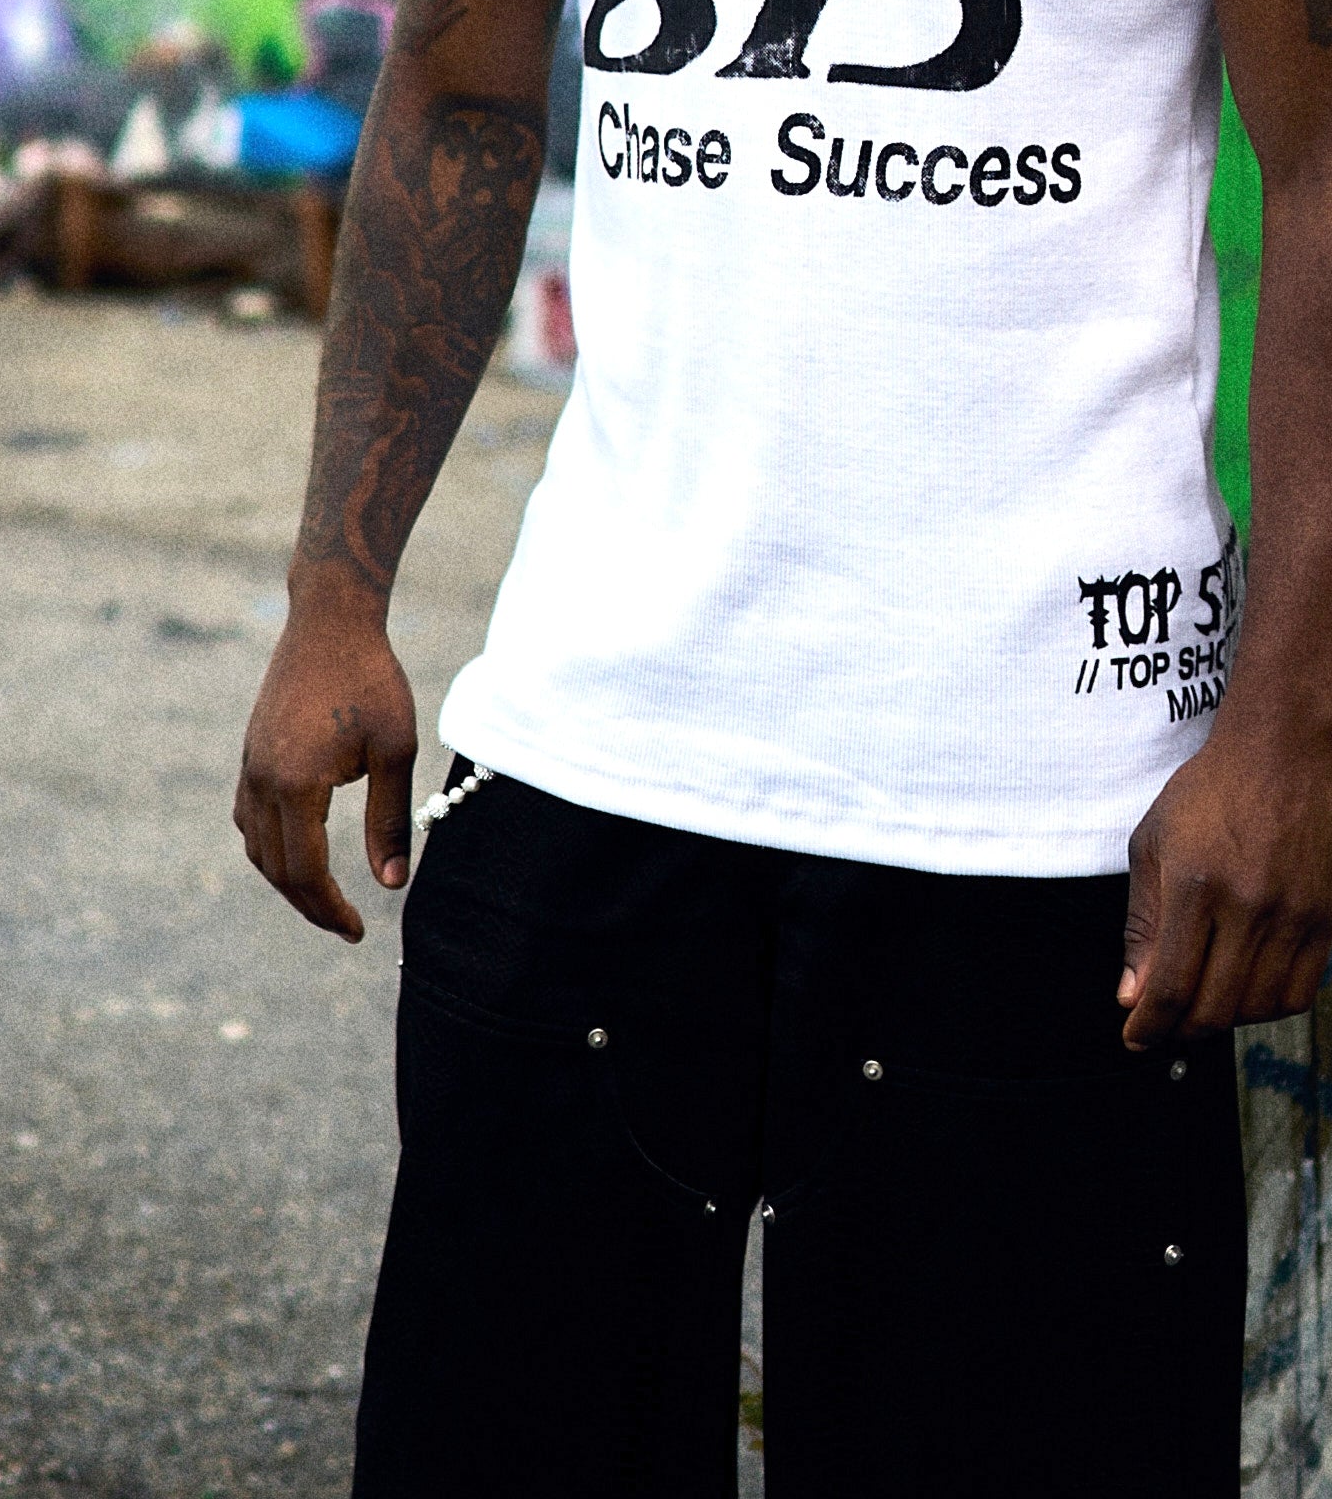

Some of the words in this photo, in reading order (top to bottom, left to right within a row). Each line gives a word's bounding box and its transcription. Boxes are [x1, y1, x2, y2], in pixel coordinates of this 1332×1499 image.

[598, 101, 731, 190] Chase
[770, 112, 1082, 208] Success
[1078, 567, 1183, 650] TOP
[1110, 651, 1170, 690] TOP
